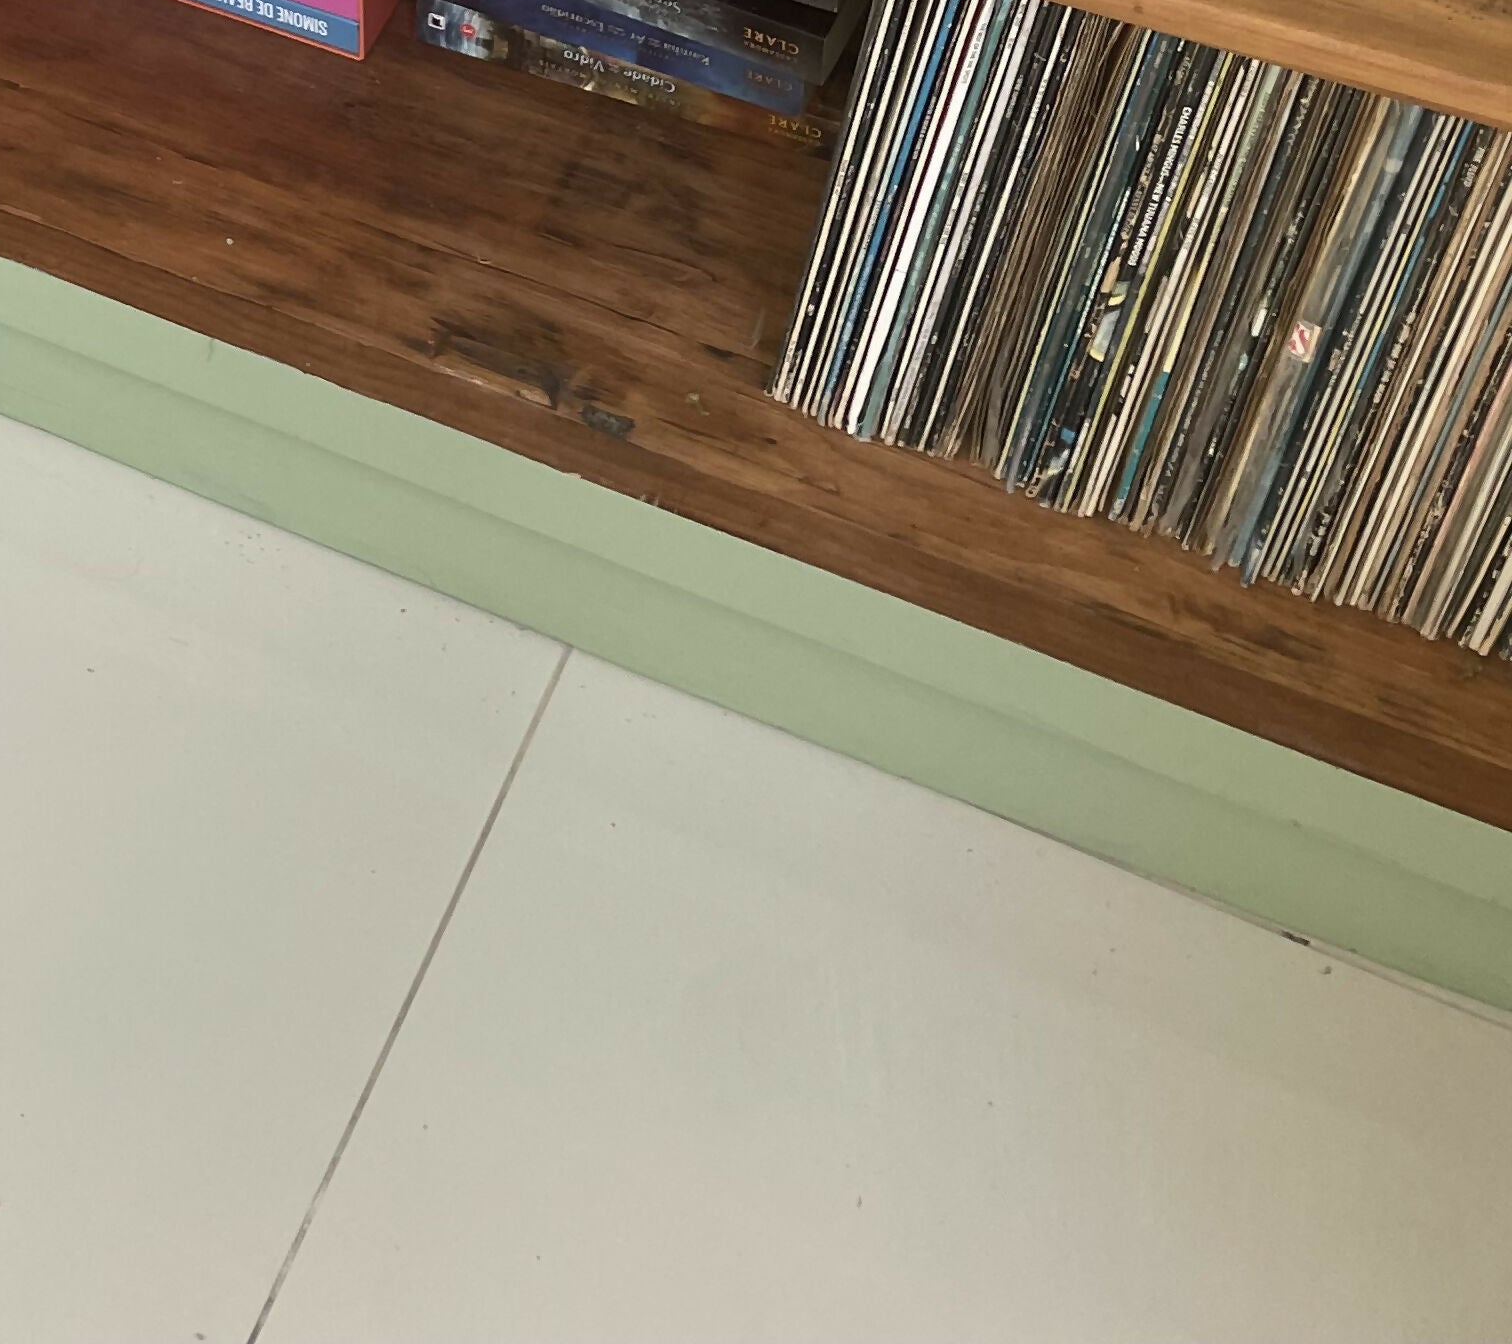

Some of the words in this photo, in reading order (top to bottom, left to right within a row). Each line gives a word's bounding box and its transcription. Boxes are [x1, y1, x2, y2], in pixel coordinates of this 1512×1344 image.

[255, 0, 274, 21] DE
[276, 9, 328, 37] SIMONE
[743, 25, 800, 55] CLARE
[562, 47, 606, 73] Vidro
[1171, 106, 1193, 145] CHARLES
[1139, 201, 1159, 239] TIJUANA
